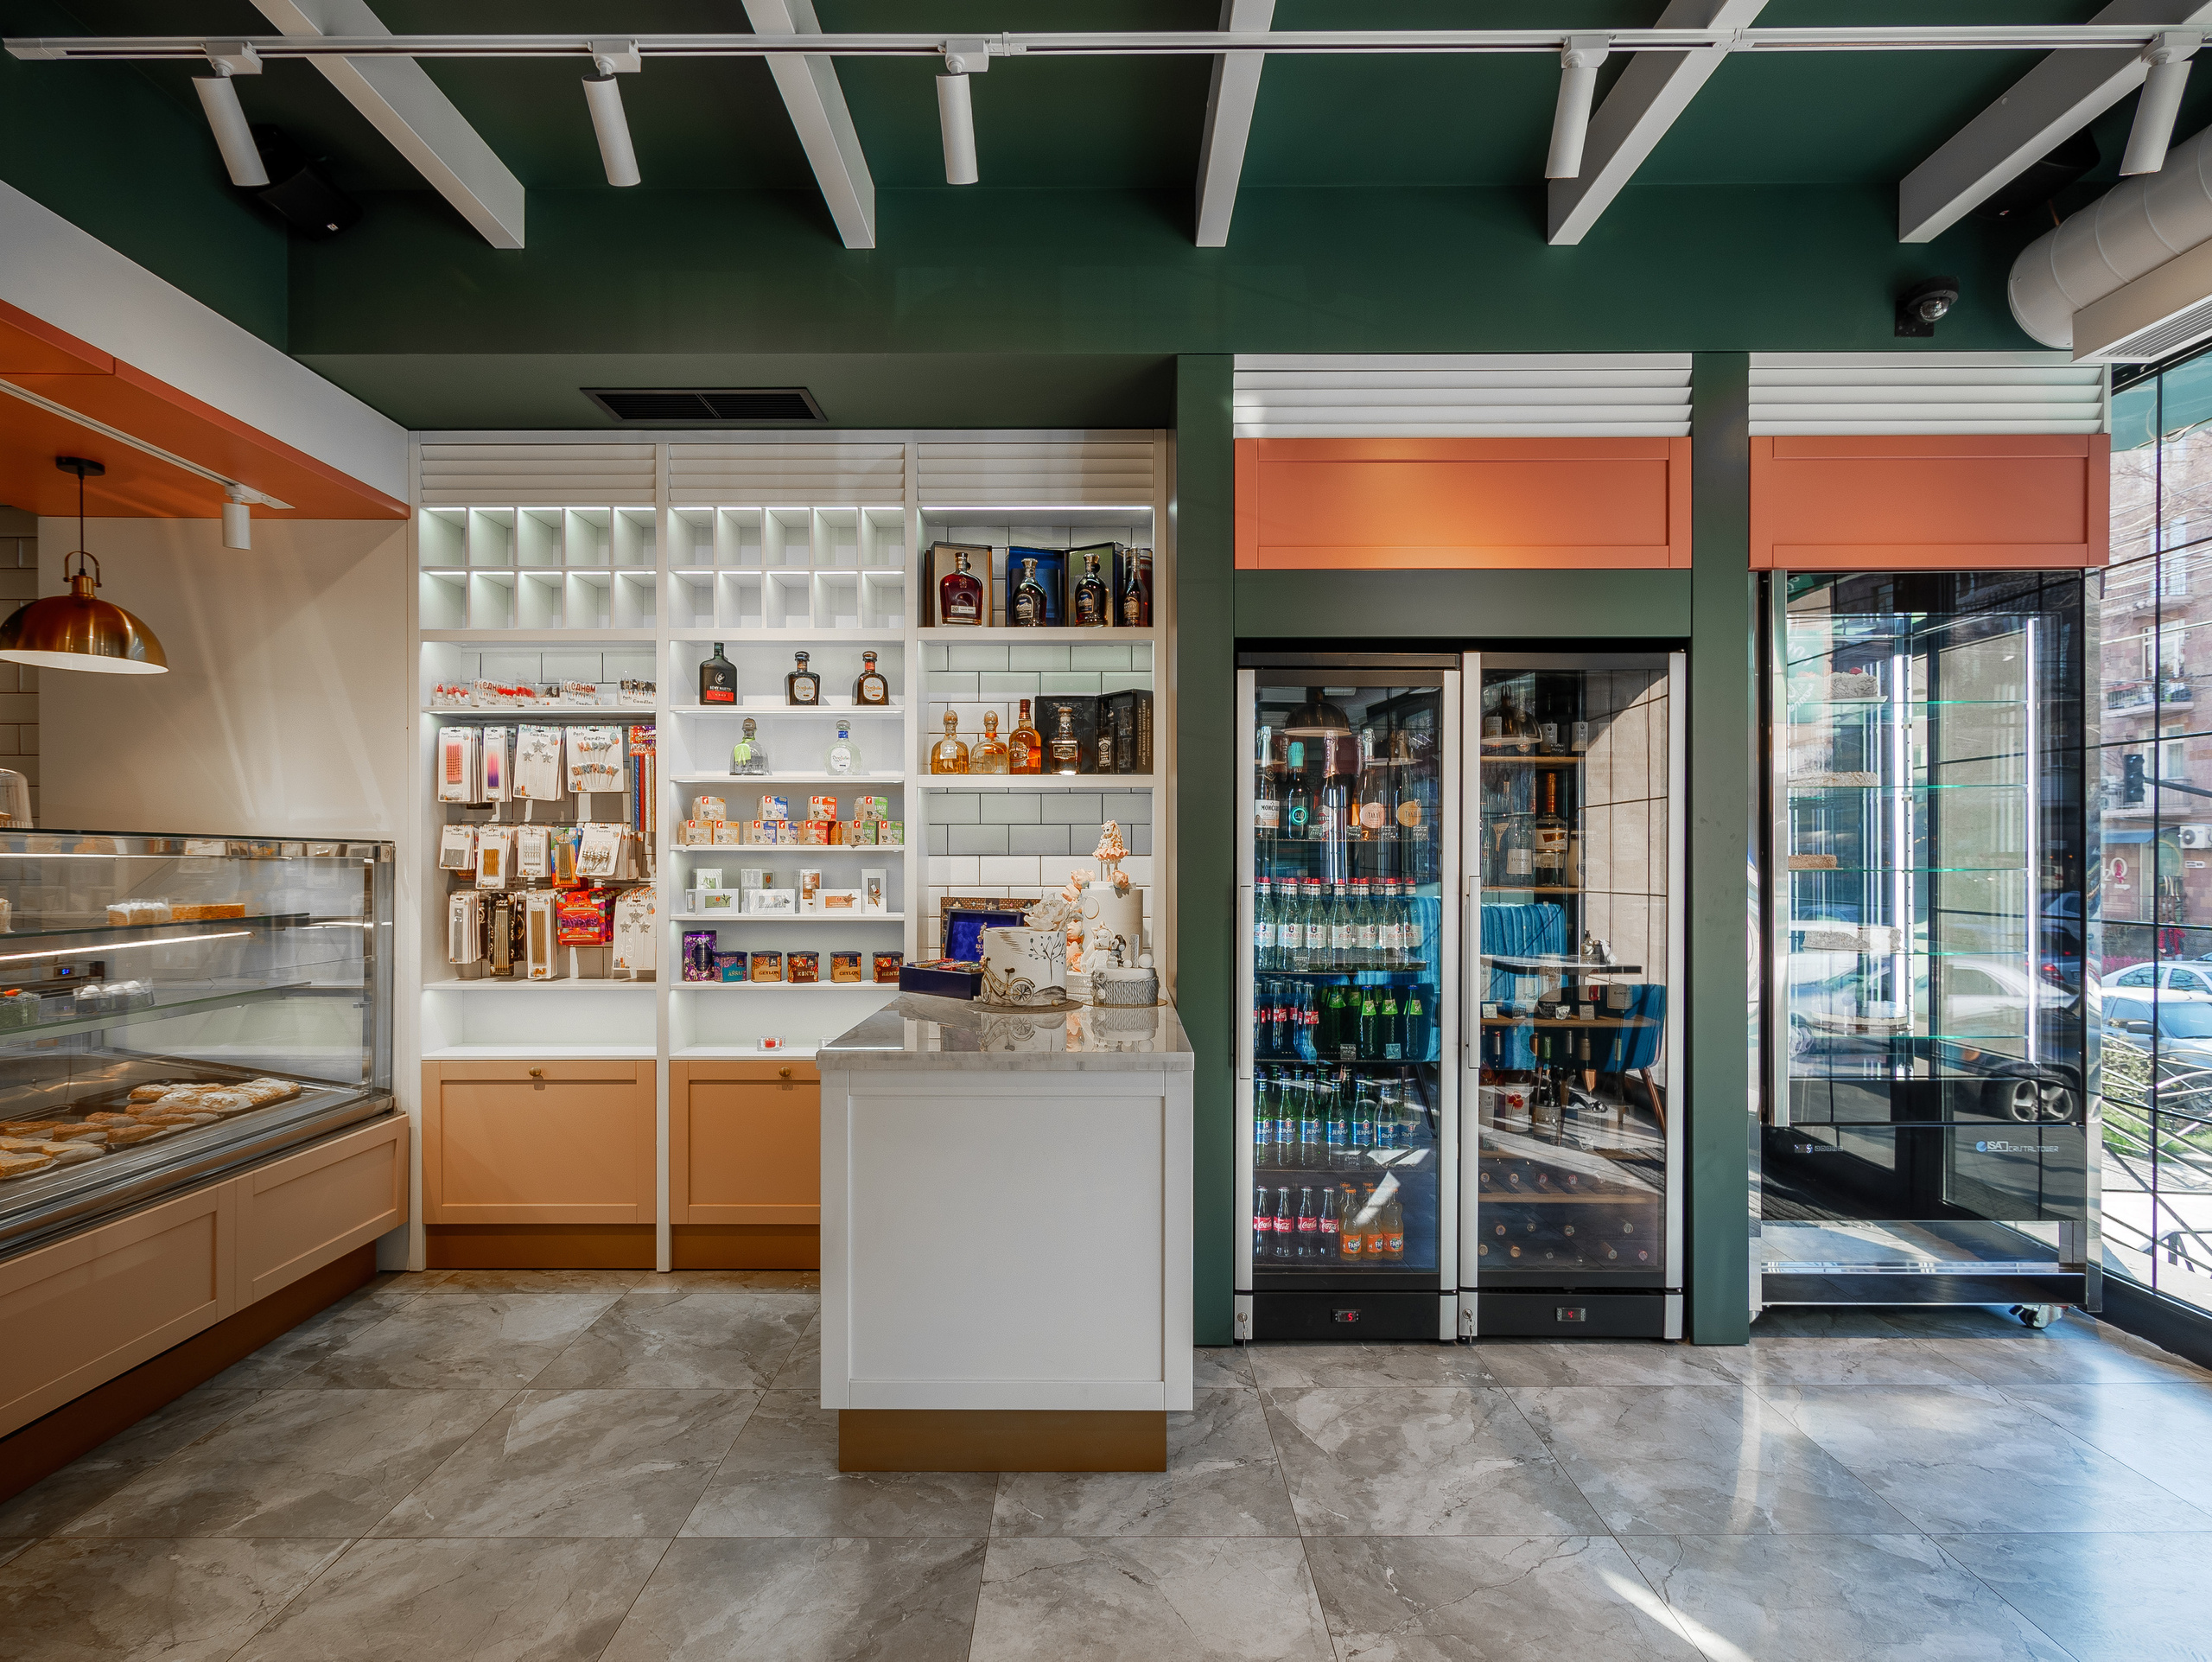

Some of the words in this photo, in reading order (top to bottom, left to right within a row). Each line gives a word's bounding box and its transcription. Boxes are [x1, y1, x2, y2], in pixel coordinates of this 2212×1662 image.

[577, 742, 612, 752] HAPPY
[571, 763, 620, 777] BIRTHDAY
[1987, 1141, 2002, 1149] ISA
[1348, 1313, 1353, 1321] 5
